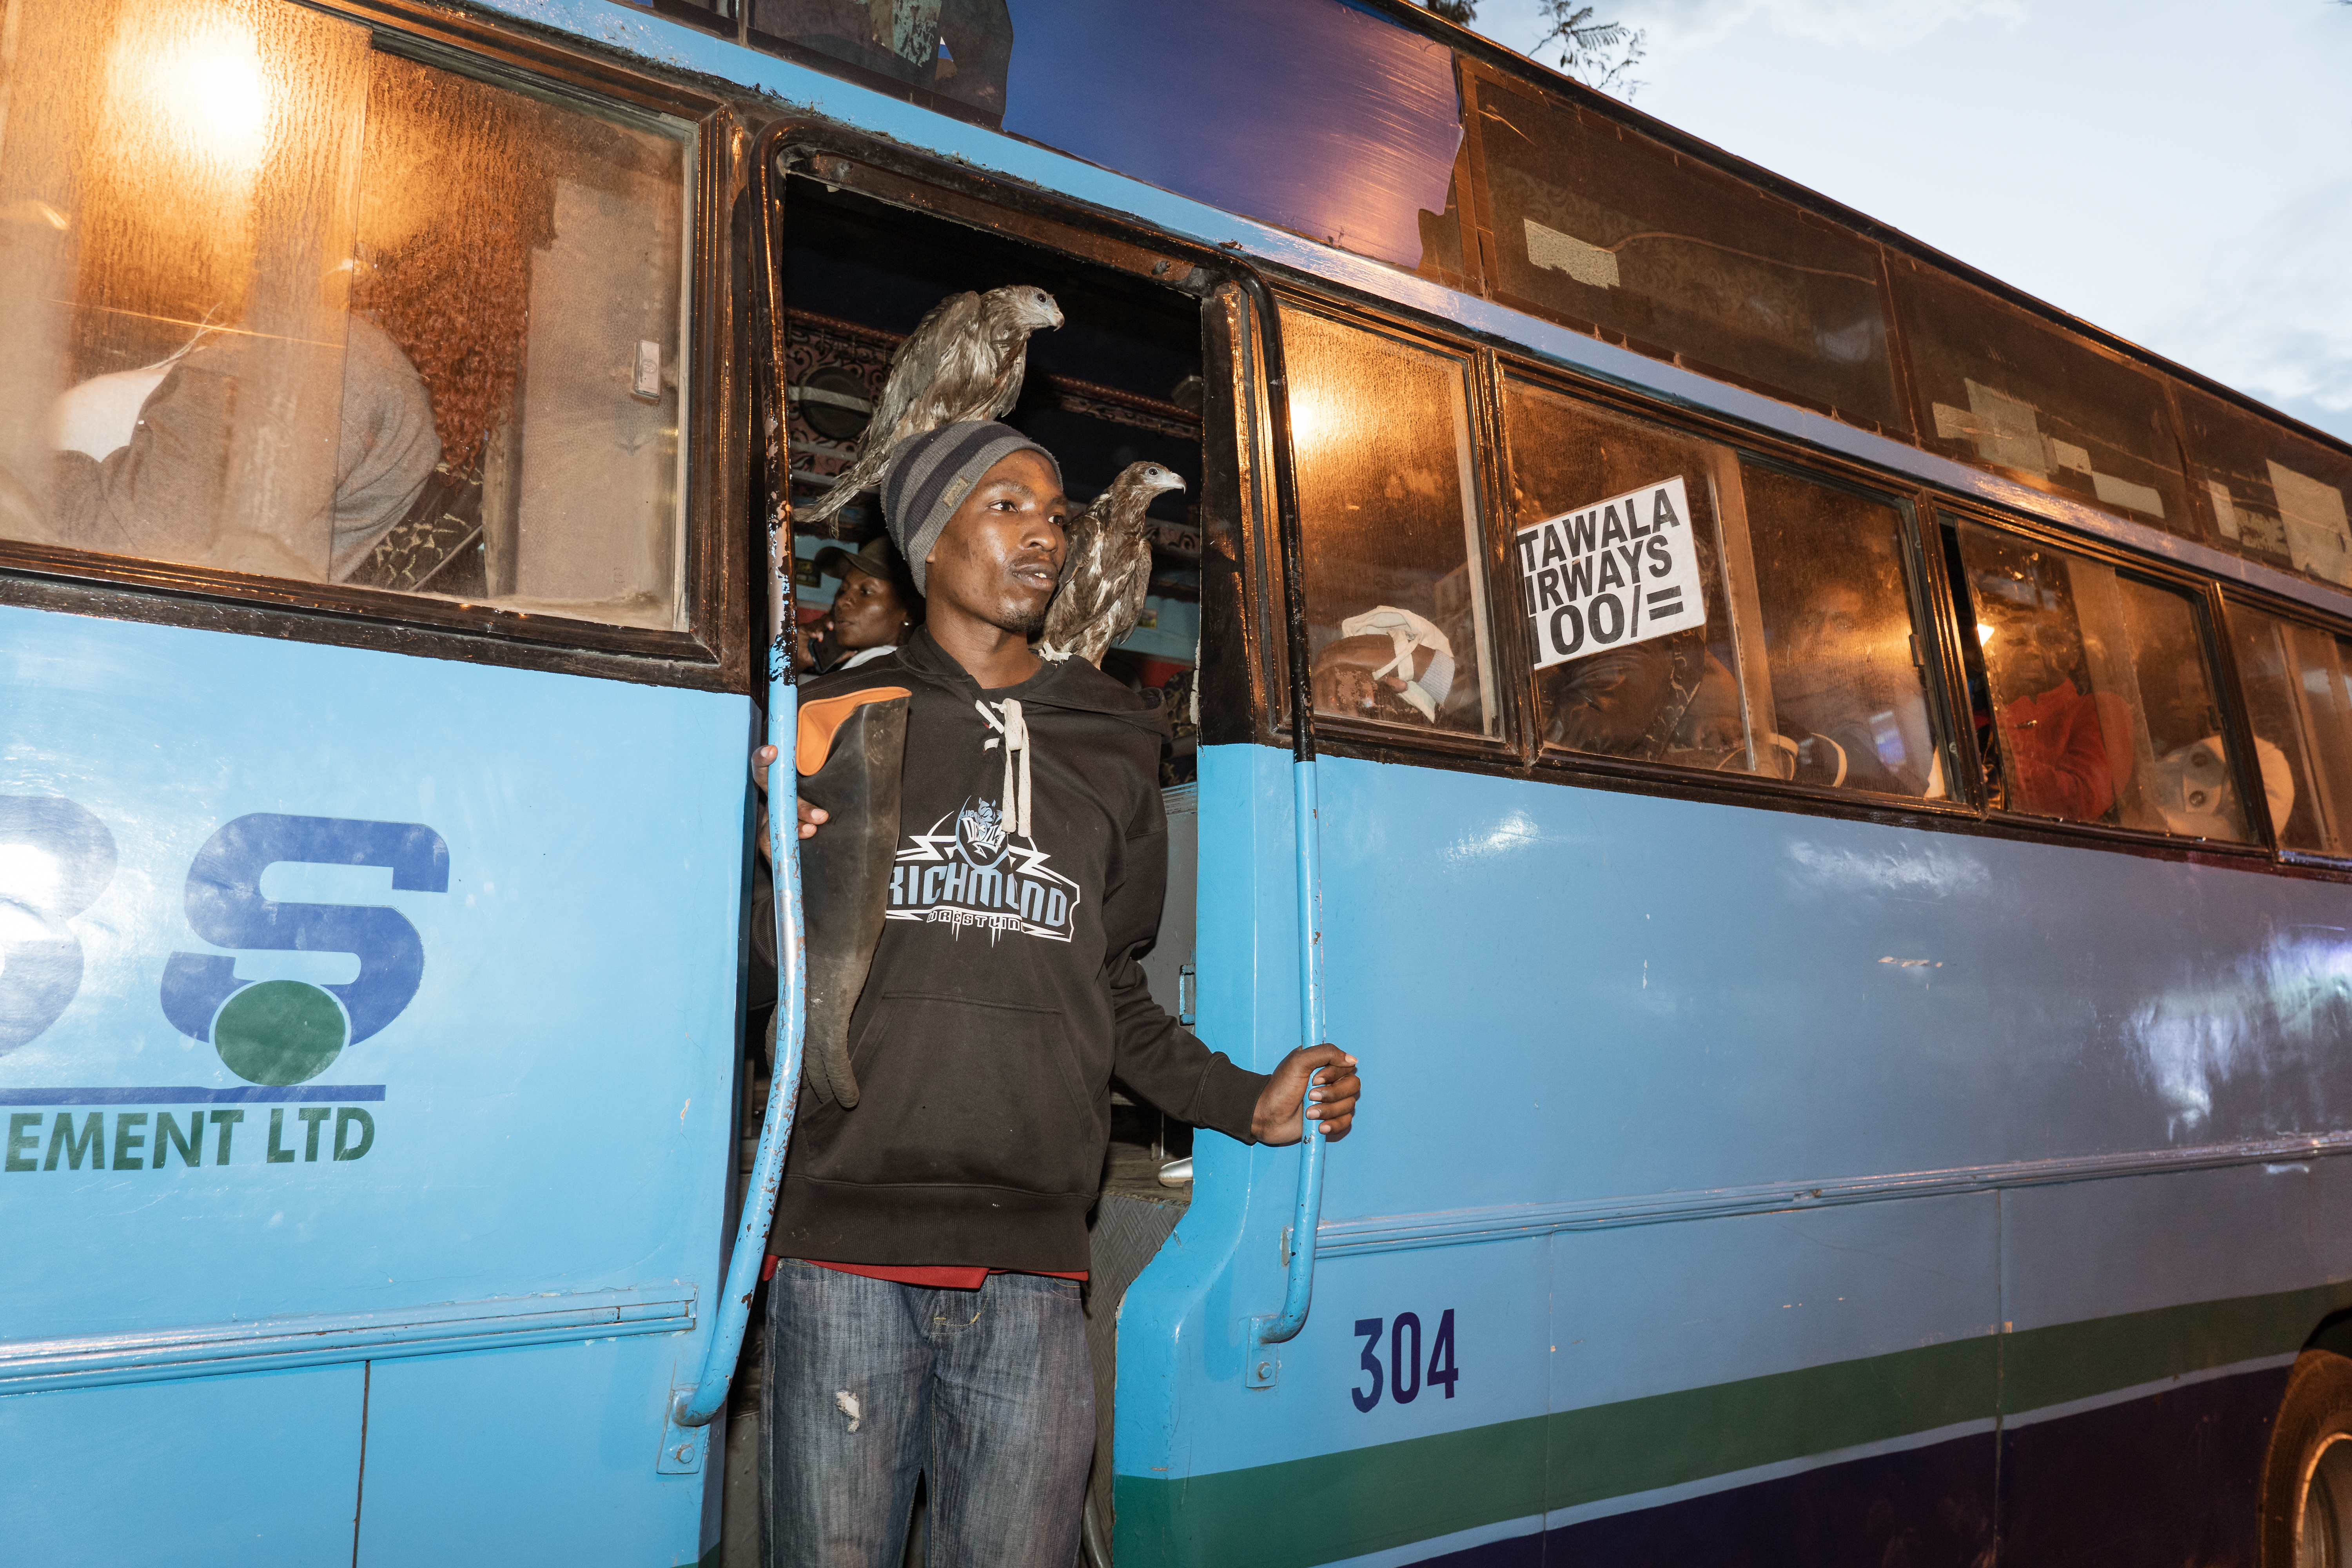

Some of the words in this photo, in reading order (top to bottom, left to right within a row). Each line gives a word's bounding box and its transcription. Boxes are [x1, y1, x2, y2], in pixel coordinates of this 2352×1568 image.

[1516, 488, 1680, 572] TAWALA
[4, 1109, 244, 1172] EMENT
[266, 1107, 375, 1164] LTD
[1351, 1308, 1459, 1414] 304
